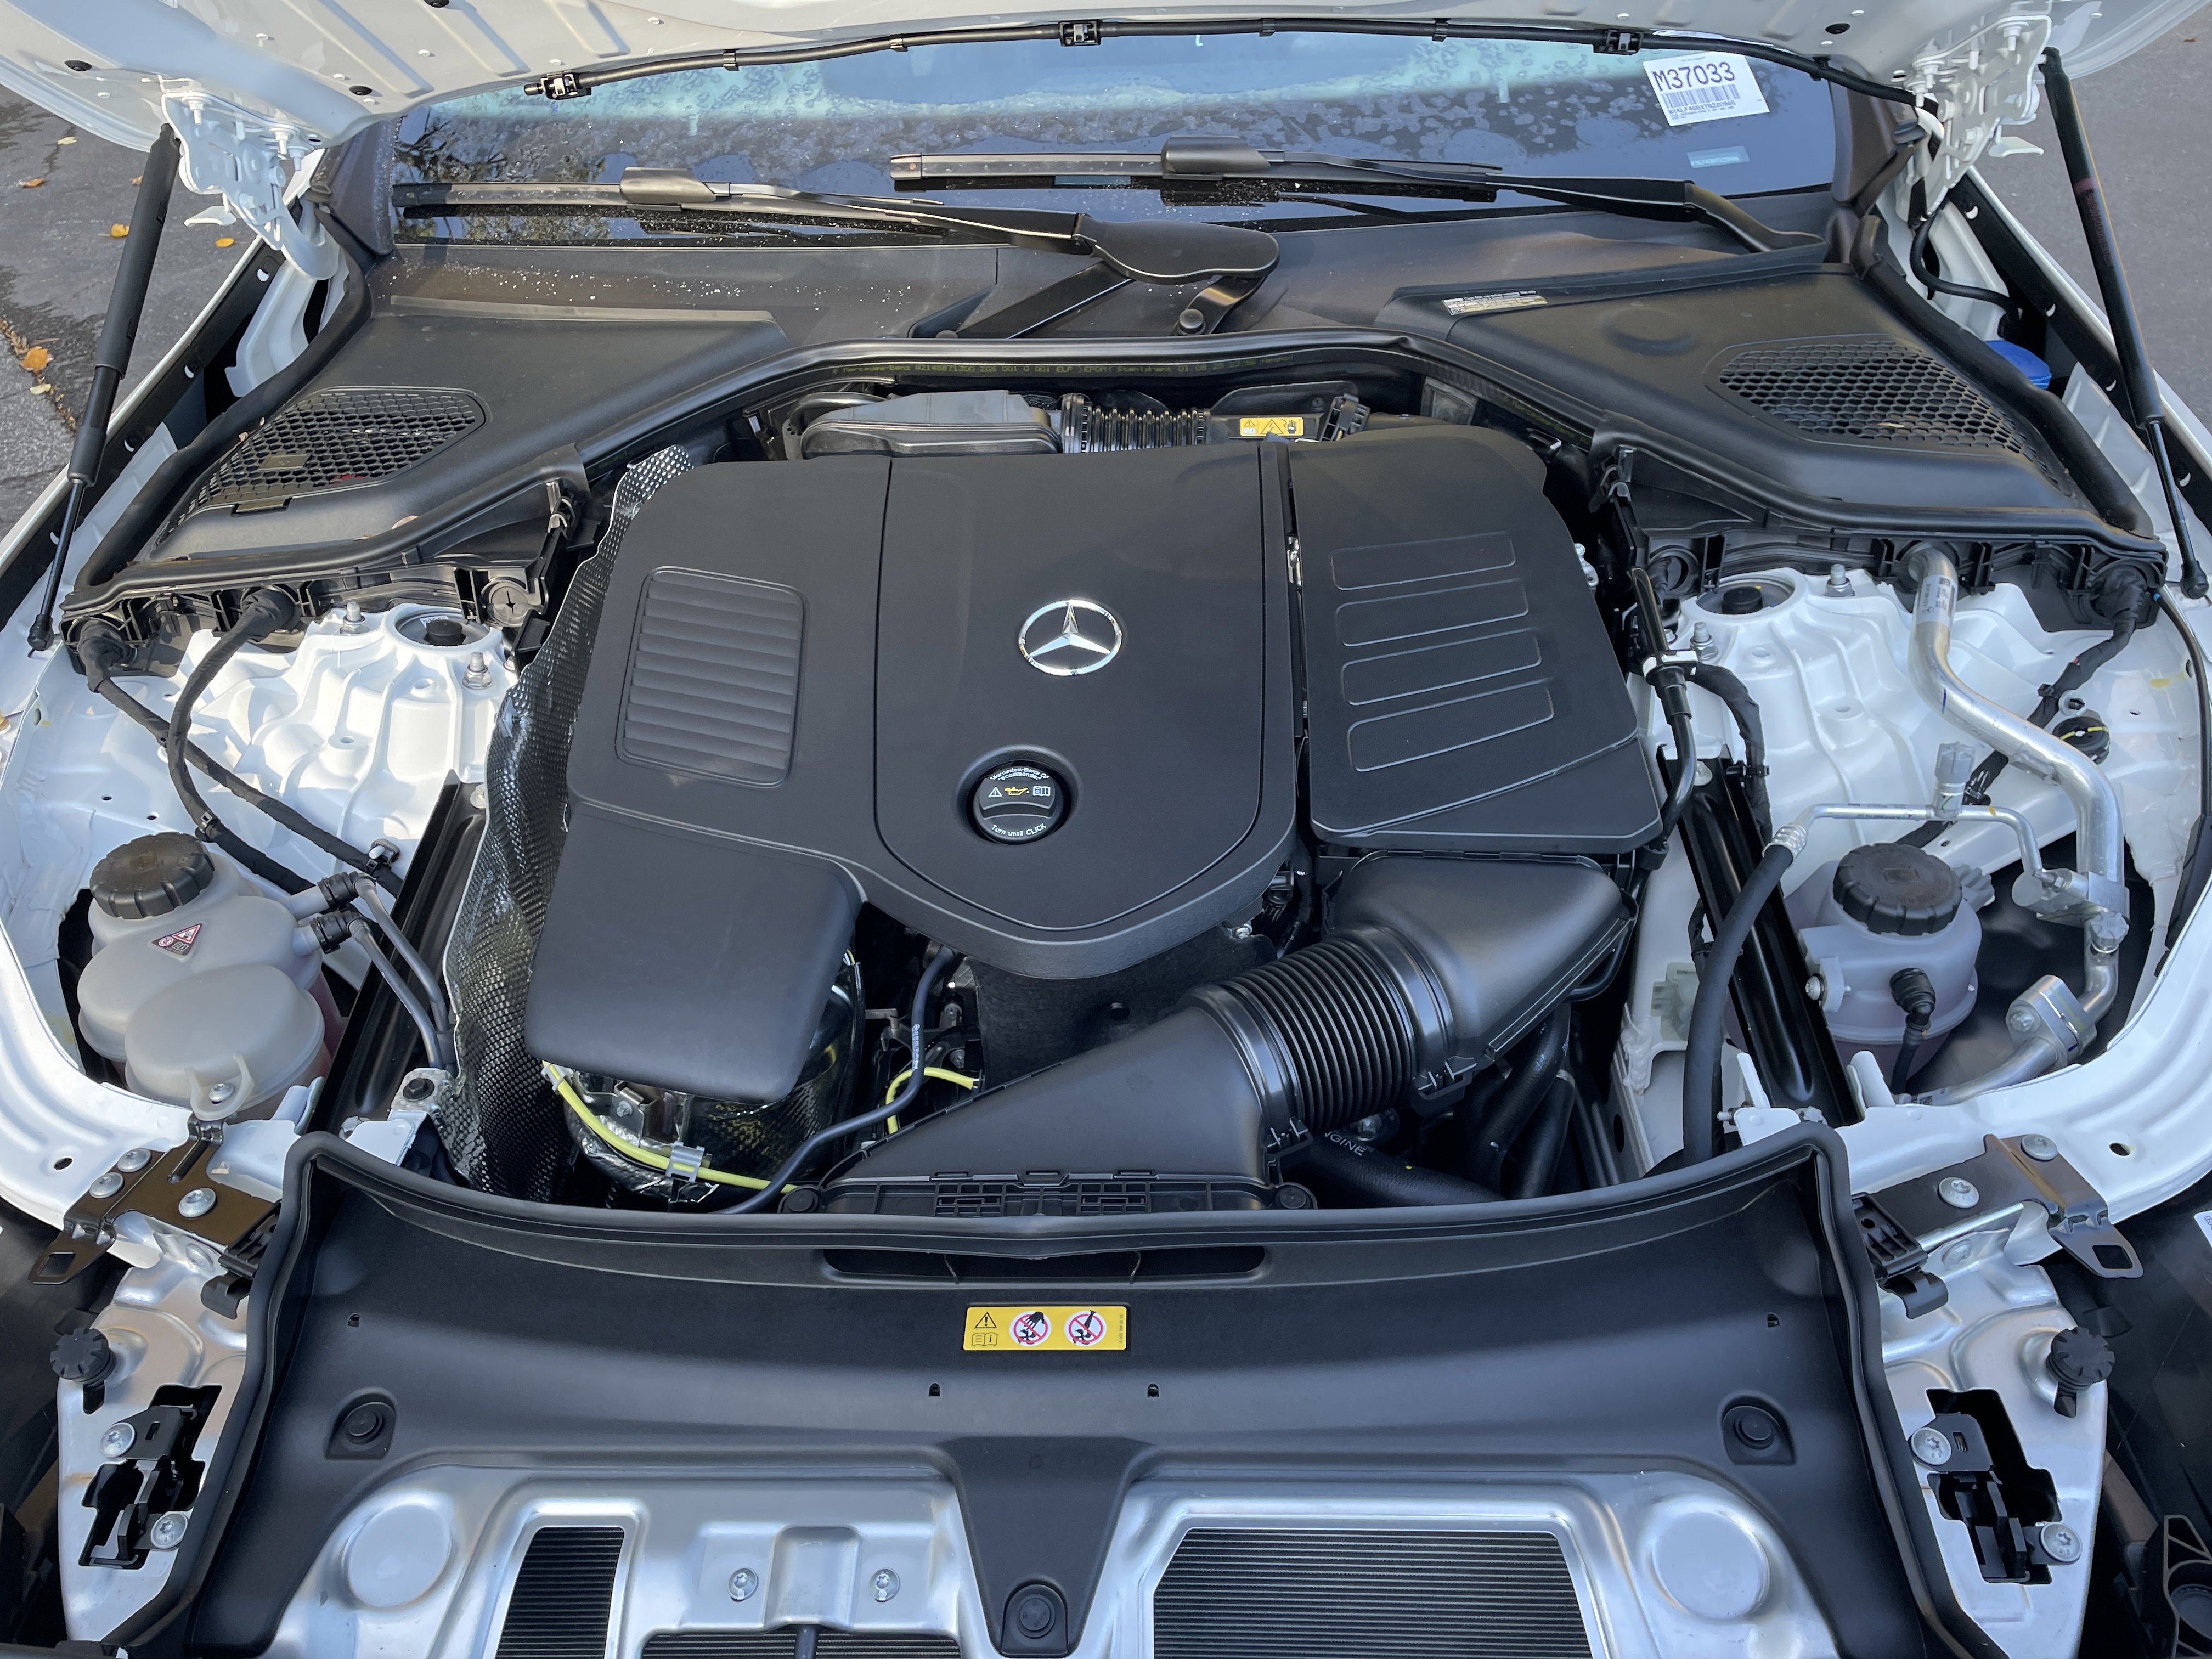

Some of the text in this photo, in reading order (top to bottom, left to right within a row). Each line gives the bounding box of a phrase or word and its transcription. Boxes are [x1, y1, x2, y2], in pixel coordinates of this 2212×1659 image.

[1651, 61, 1735, 92] M37033
[843, 365, 911, 373] Mercedes-Benz
[990, 767, 1040, 780] Mercedes-Benz
[992, 825, 1006, 835] Turn
[1026, 823, 1047, 836] CLICK
